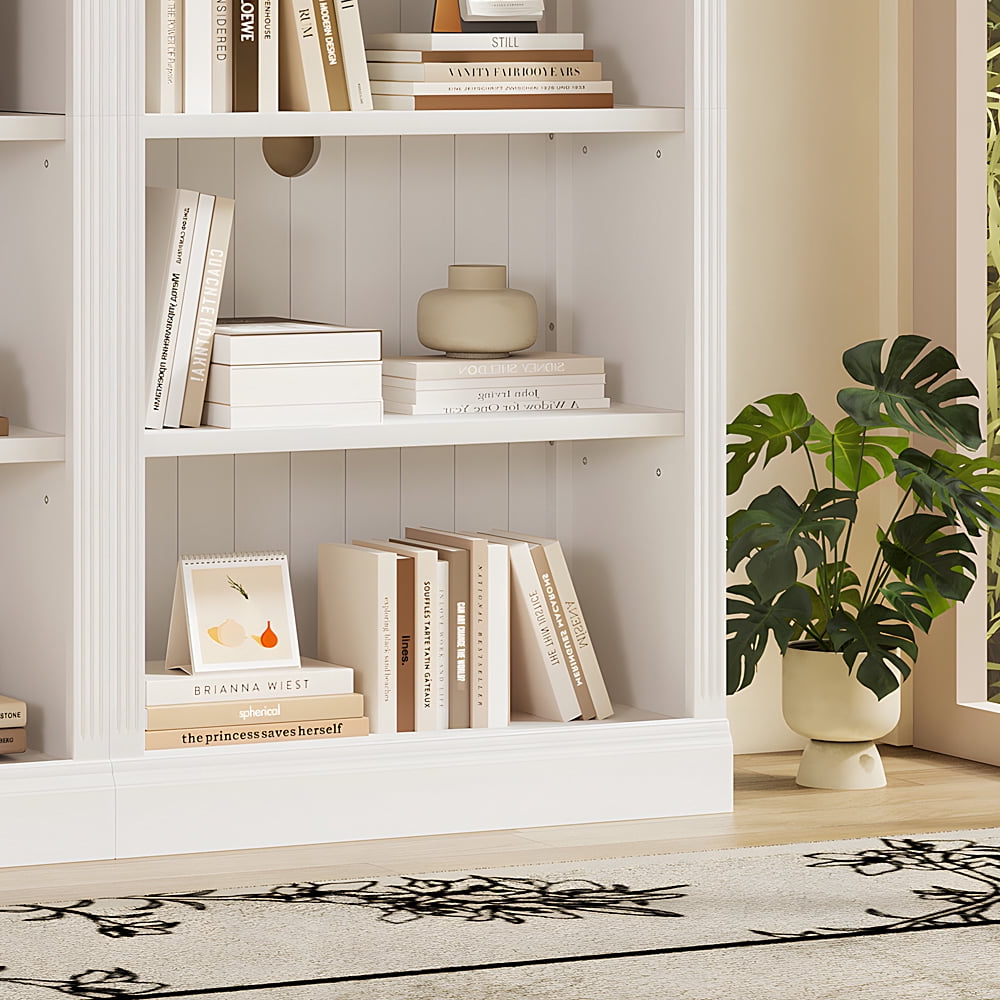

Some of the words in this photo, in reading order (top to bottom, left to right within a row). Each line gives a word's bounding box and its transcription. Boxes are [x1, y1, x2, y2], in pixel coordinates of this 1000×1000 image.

[298, 8, 313, 39] RUM
[319, 2, 332, 36] MODERN
[324, 36, 337, 65] DESIGN
[492, 37, 519, 48] STILL
[449, 68, 490, 77] VANITY
[402, 635, 410, 666] lines.
[194, 683, 260, 695] BRIANNA
[268, 680, 310, 690] WIEST
[0, 712, 21, 720] STONE
[239, 704, 280, 720] spherical
[182, 733, 203, 744] the
[205, 729, 259, 744] princess
[261, 728, 296, 738] saves
[298, 723, 344, 736] herself
